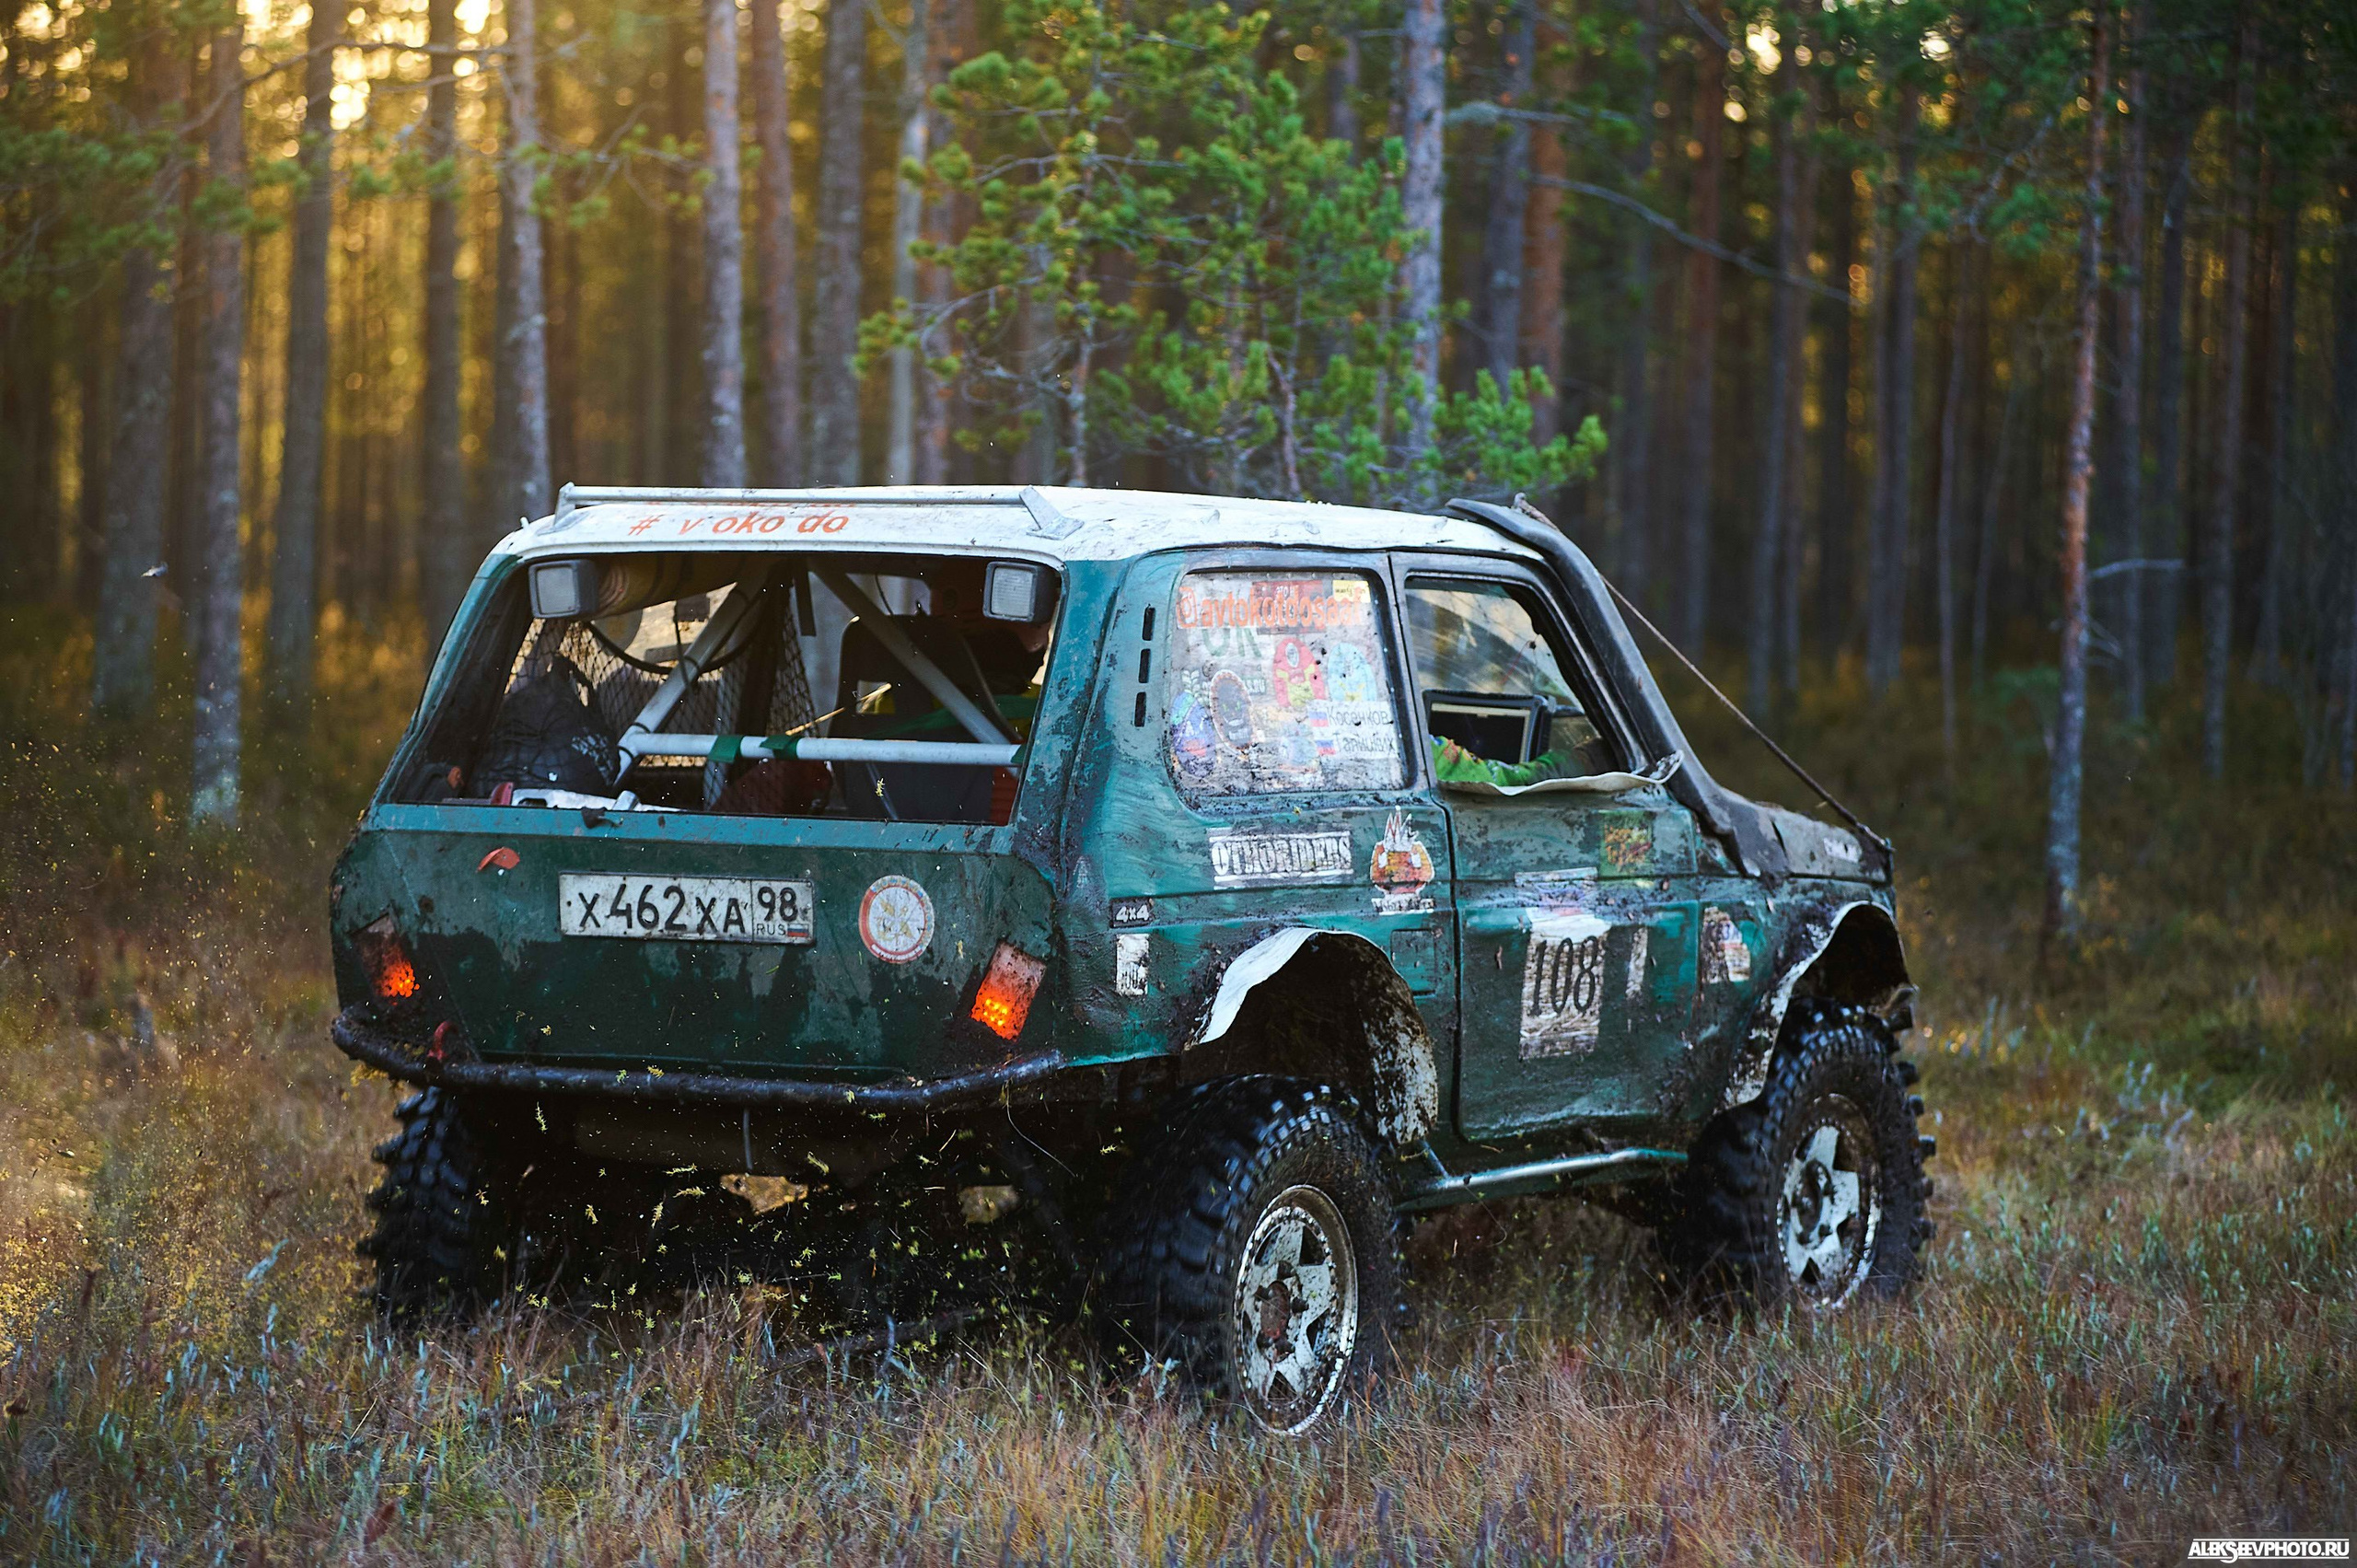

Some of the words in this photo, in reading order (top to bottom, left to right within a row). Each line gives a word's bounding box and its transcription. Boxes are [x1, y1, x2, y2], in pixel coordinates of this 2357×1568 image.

[712, 511, 785, 534] oko
[797, 510, 849, 534] do
[1176, 583, 1363, 628] @avtokotdosaaf
[757, 886, 799, 922] 98
[756, 923, 786, 936] RUS
[1529, 935, 1598, 1016] 108
